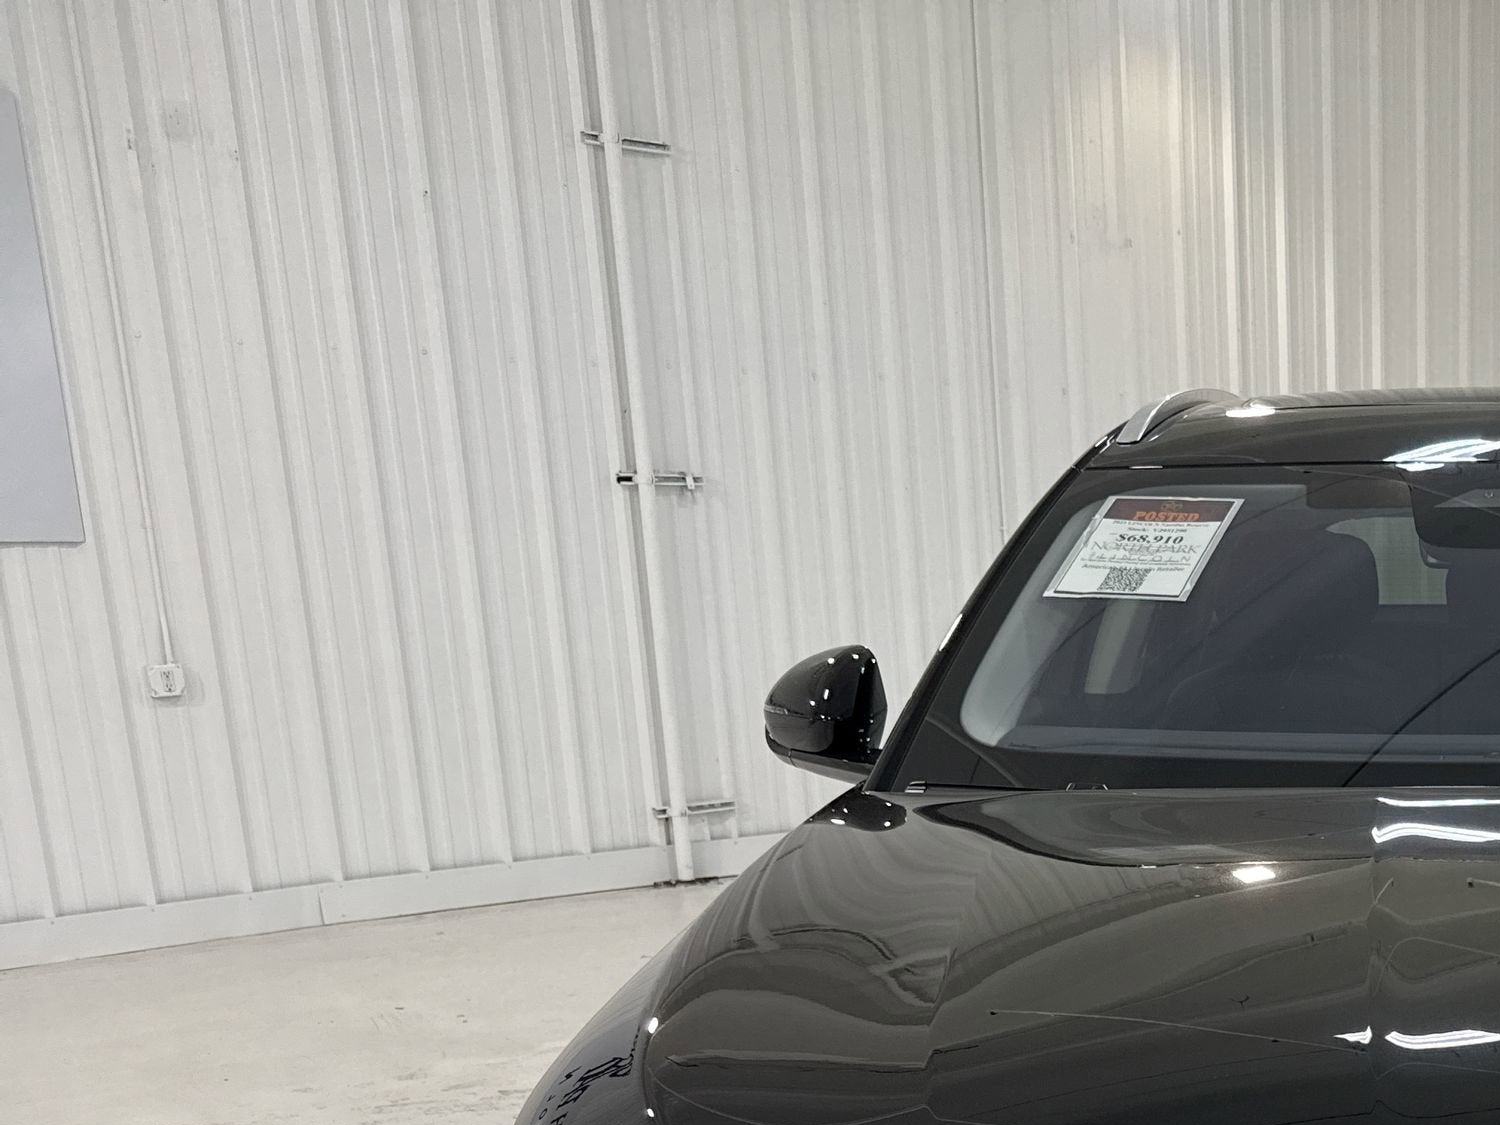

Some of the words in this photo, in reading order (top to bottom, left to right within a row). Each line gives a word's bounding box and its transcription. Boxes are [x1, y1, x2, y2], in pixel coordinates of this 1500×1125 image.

[1133, 511, 1200, 522] POSTED
[1115, 533, 1185, 545] $68,910
[1155, 543, 1198, 554] PARK
